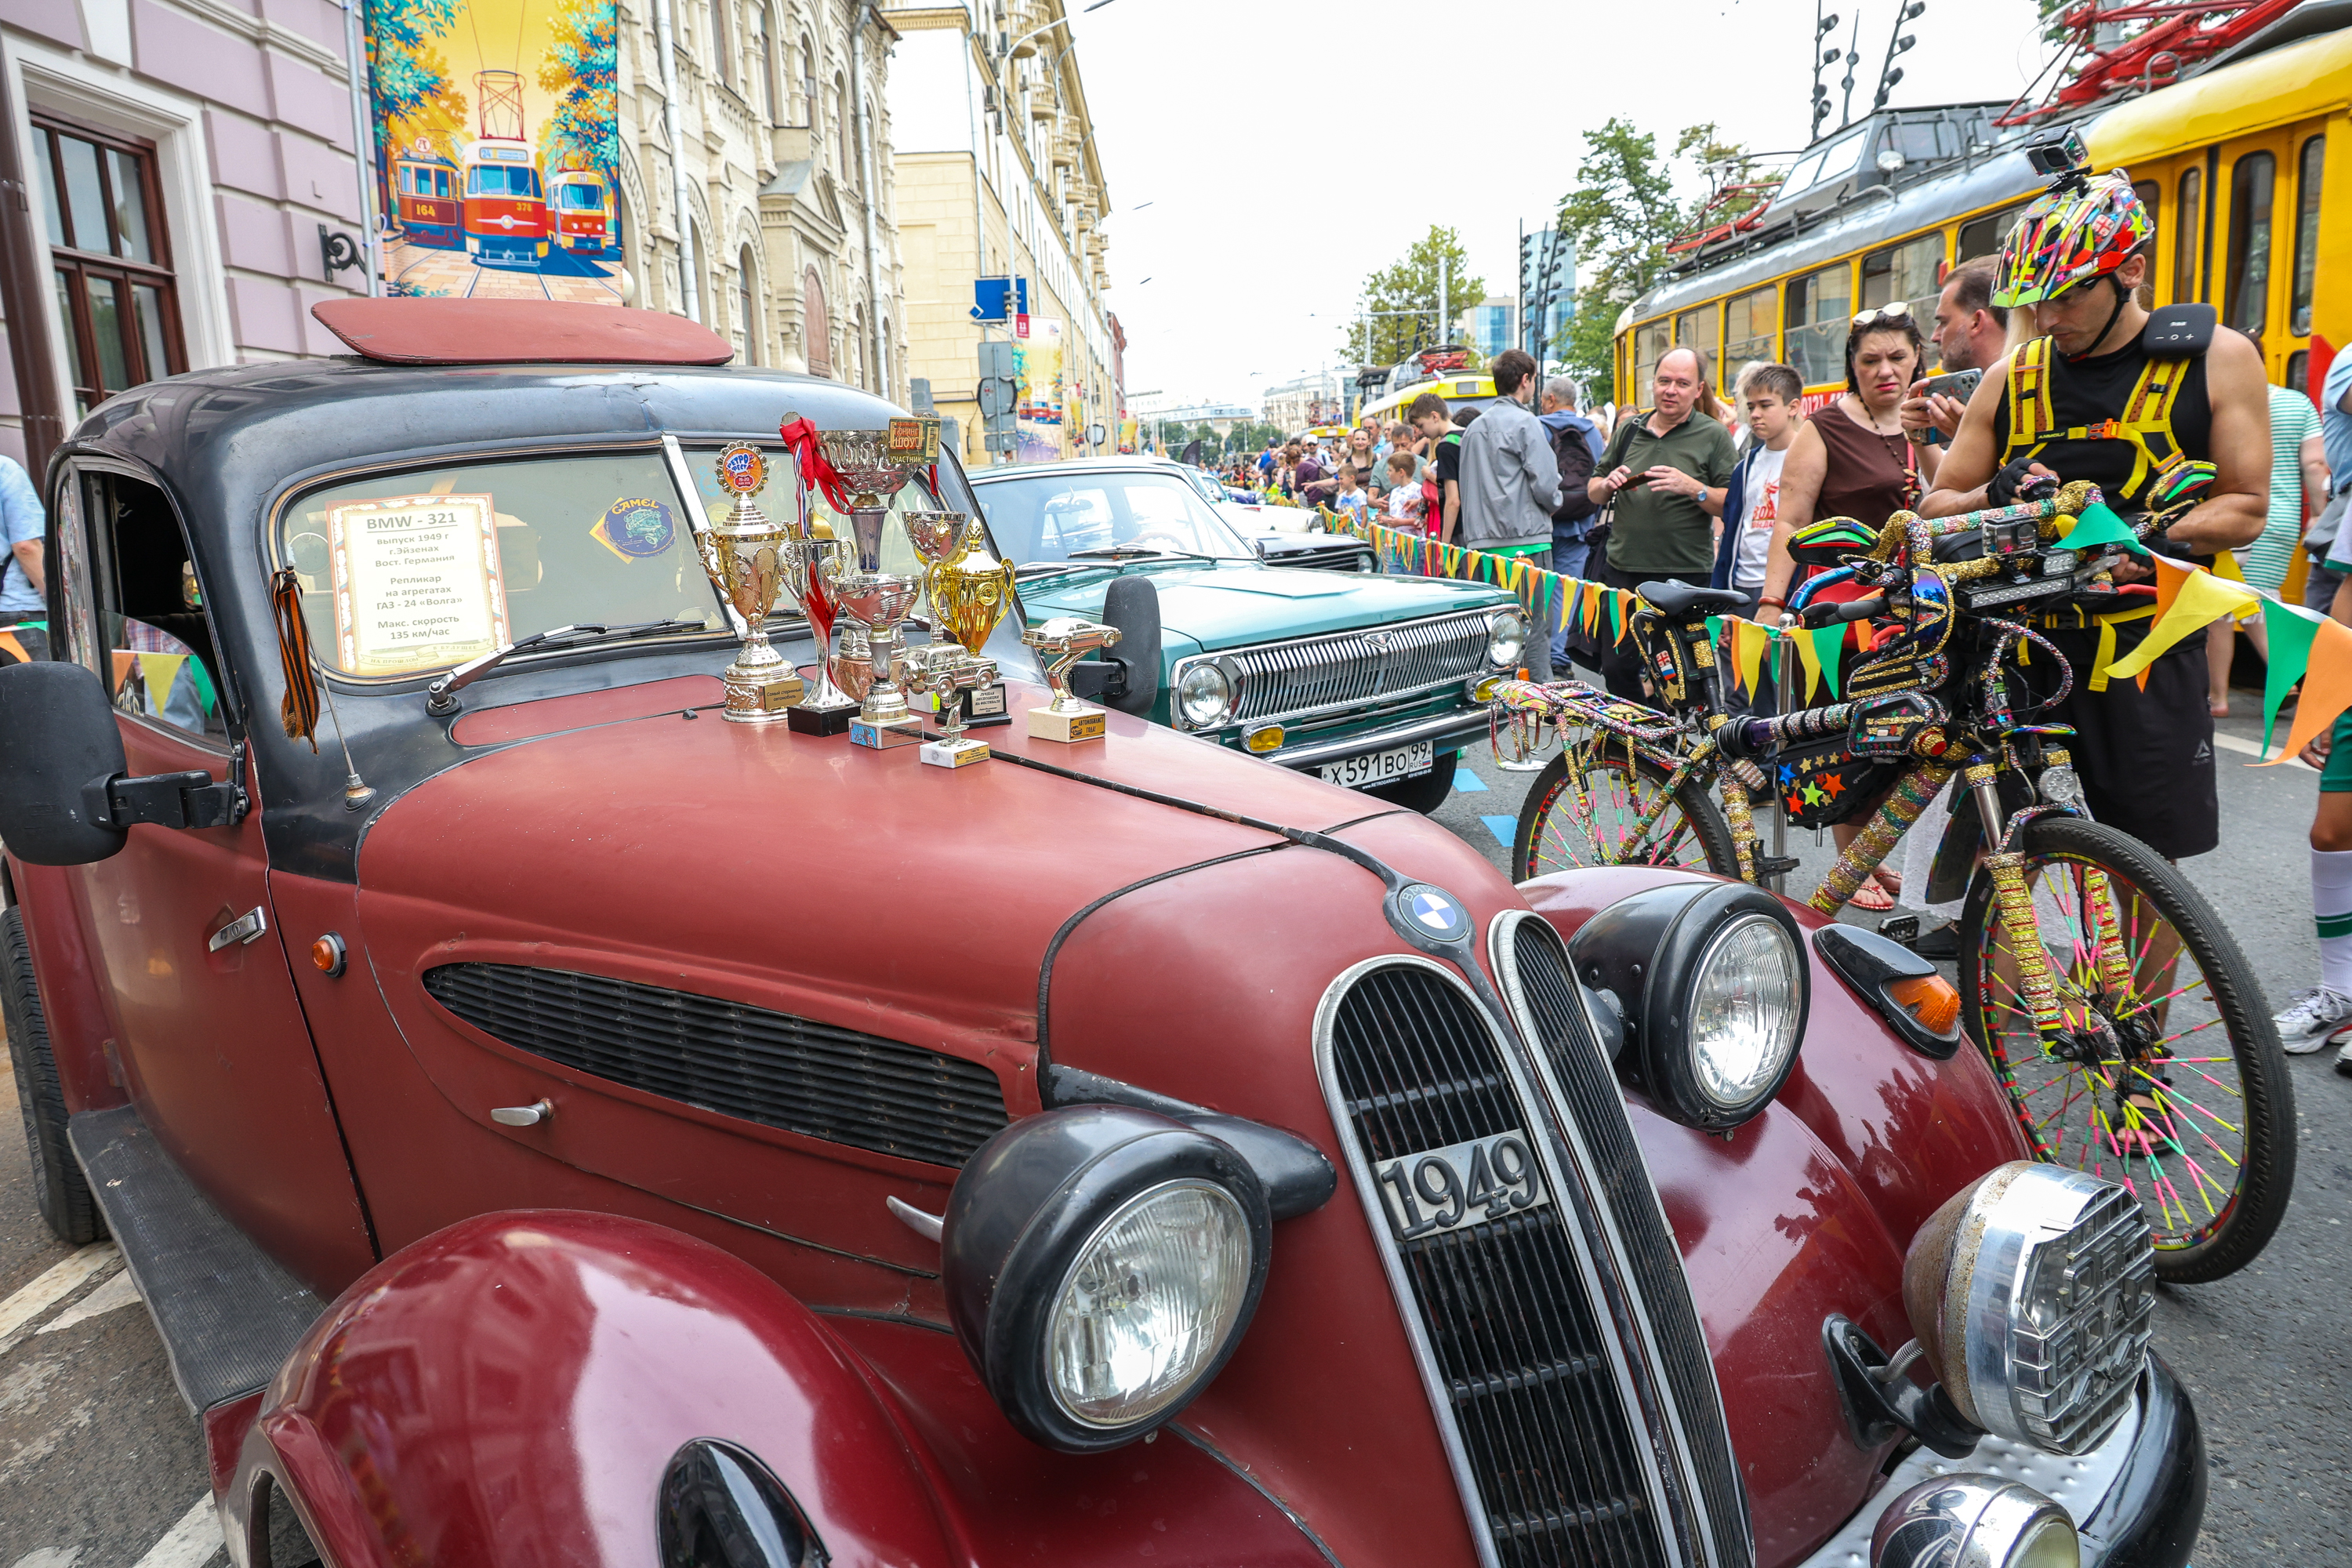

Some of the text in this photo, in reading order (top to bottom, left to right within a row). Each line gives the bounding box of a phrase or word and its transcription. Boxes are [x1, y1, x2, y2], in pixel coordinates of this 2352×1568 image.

[416, 204, 436, 216] 164
[895, 437, 915, 447] ШОУ
[727, 454, 749, 468] РЕТРО
[612, 499, 659, 514] CAMEL
[367, 516, 412, 529] BMW
[428, 513, 456, 524] 321
[376, 536, 415, 545] выпуск
[418, 533, 442, 542] 1949
[389, 546, 439, 555] г.Эйзенах
[405, 554, 455, 566] Германия
[390, 575, 441, 585] Репликар
[401, 586, 452, 597] агрегатах
[376, 601, 394, 610] ГАЗ
[405, 599, 416, 608] 24
[419, 597, 463, 607] «Волга»
[378, 616, 459, 629] Макс. скорость
[390, 628, 450, 640] 135 км/час
[1078, 716, 1104, 726] АВТОМОБИЛИСТ
[1411, 742, 1428, 761] 99
[1410, 760, 1422, 768] RUS
[1402, 885, 1437, 902] BMW
[1381, 1137, 1539, 1240] 1949
[2063, 1219, 2139, 1310] OFF
[2045, 1263, 2156, 1386] ROAD
